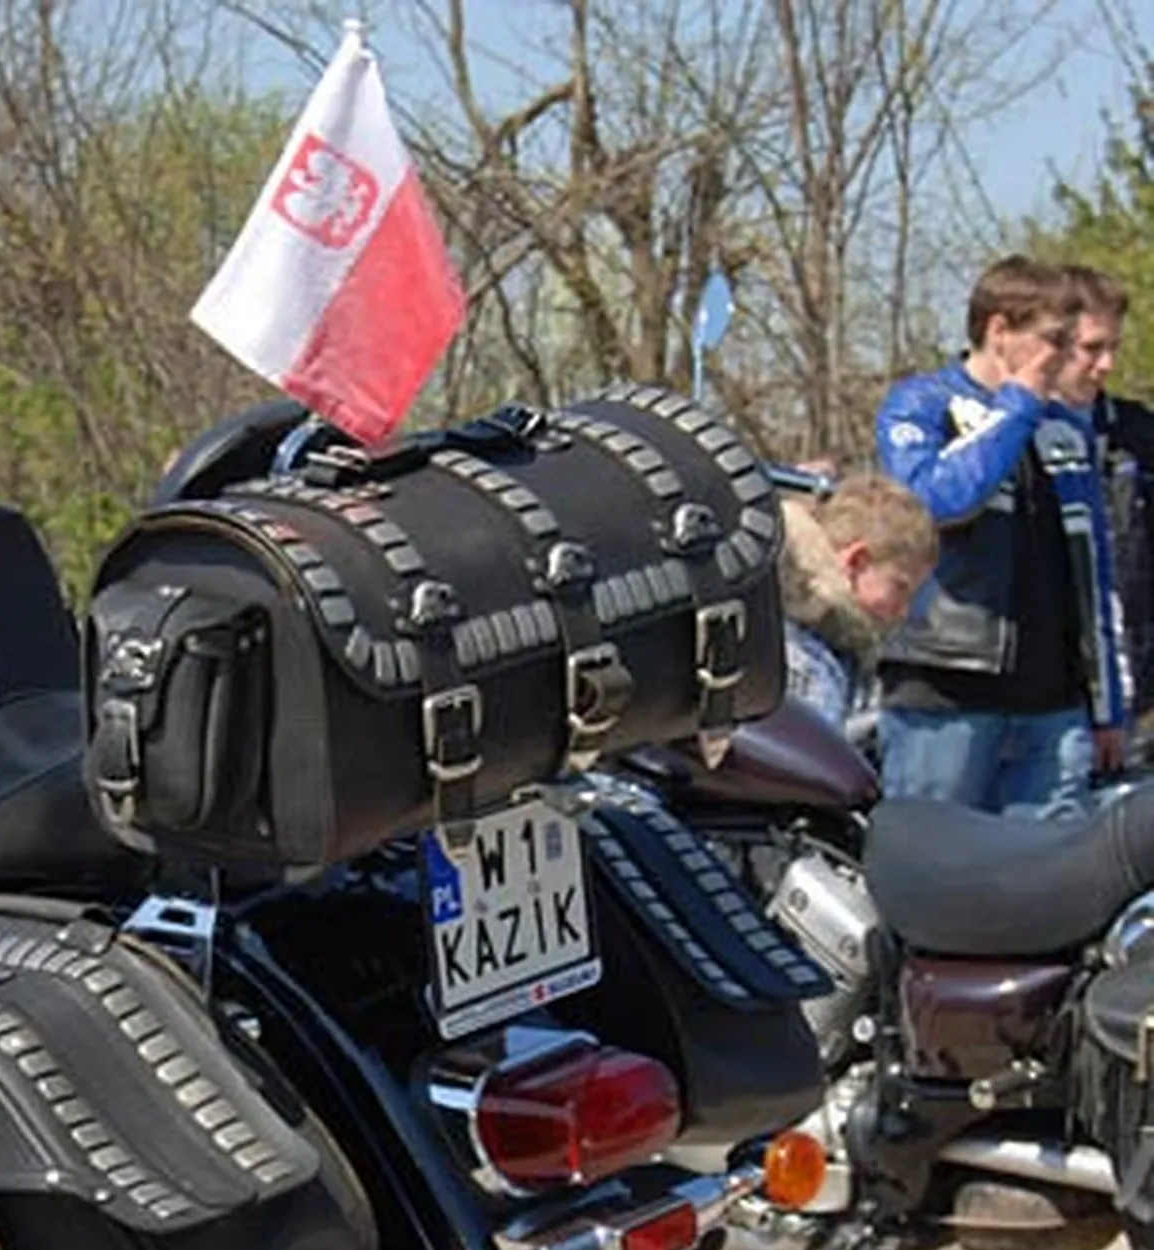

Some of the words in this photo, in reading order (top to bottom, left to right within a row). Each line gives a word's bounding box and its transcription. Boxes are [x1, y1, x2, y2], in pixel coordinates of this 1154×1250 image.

[475, 828, 506, 892] W
[520, 818, 537, 876] 1
[440, 885, 581, 988] KAZIK
